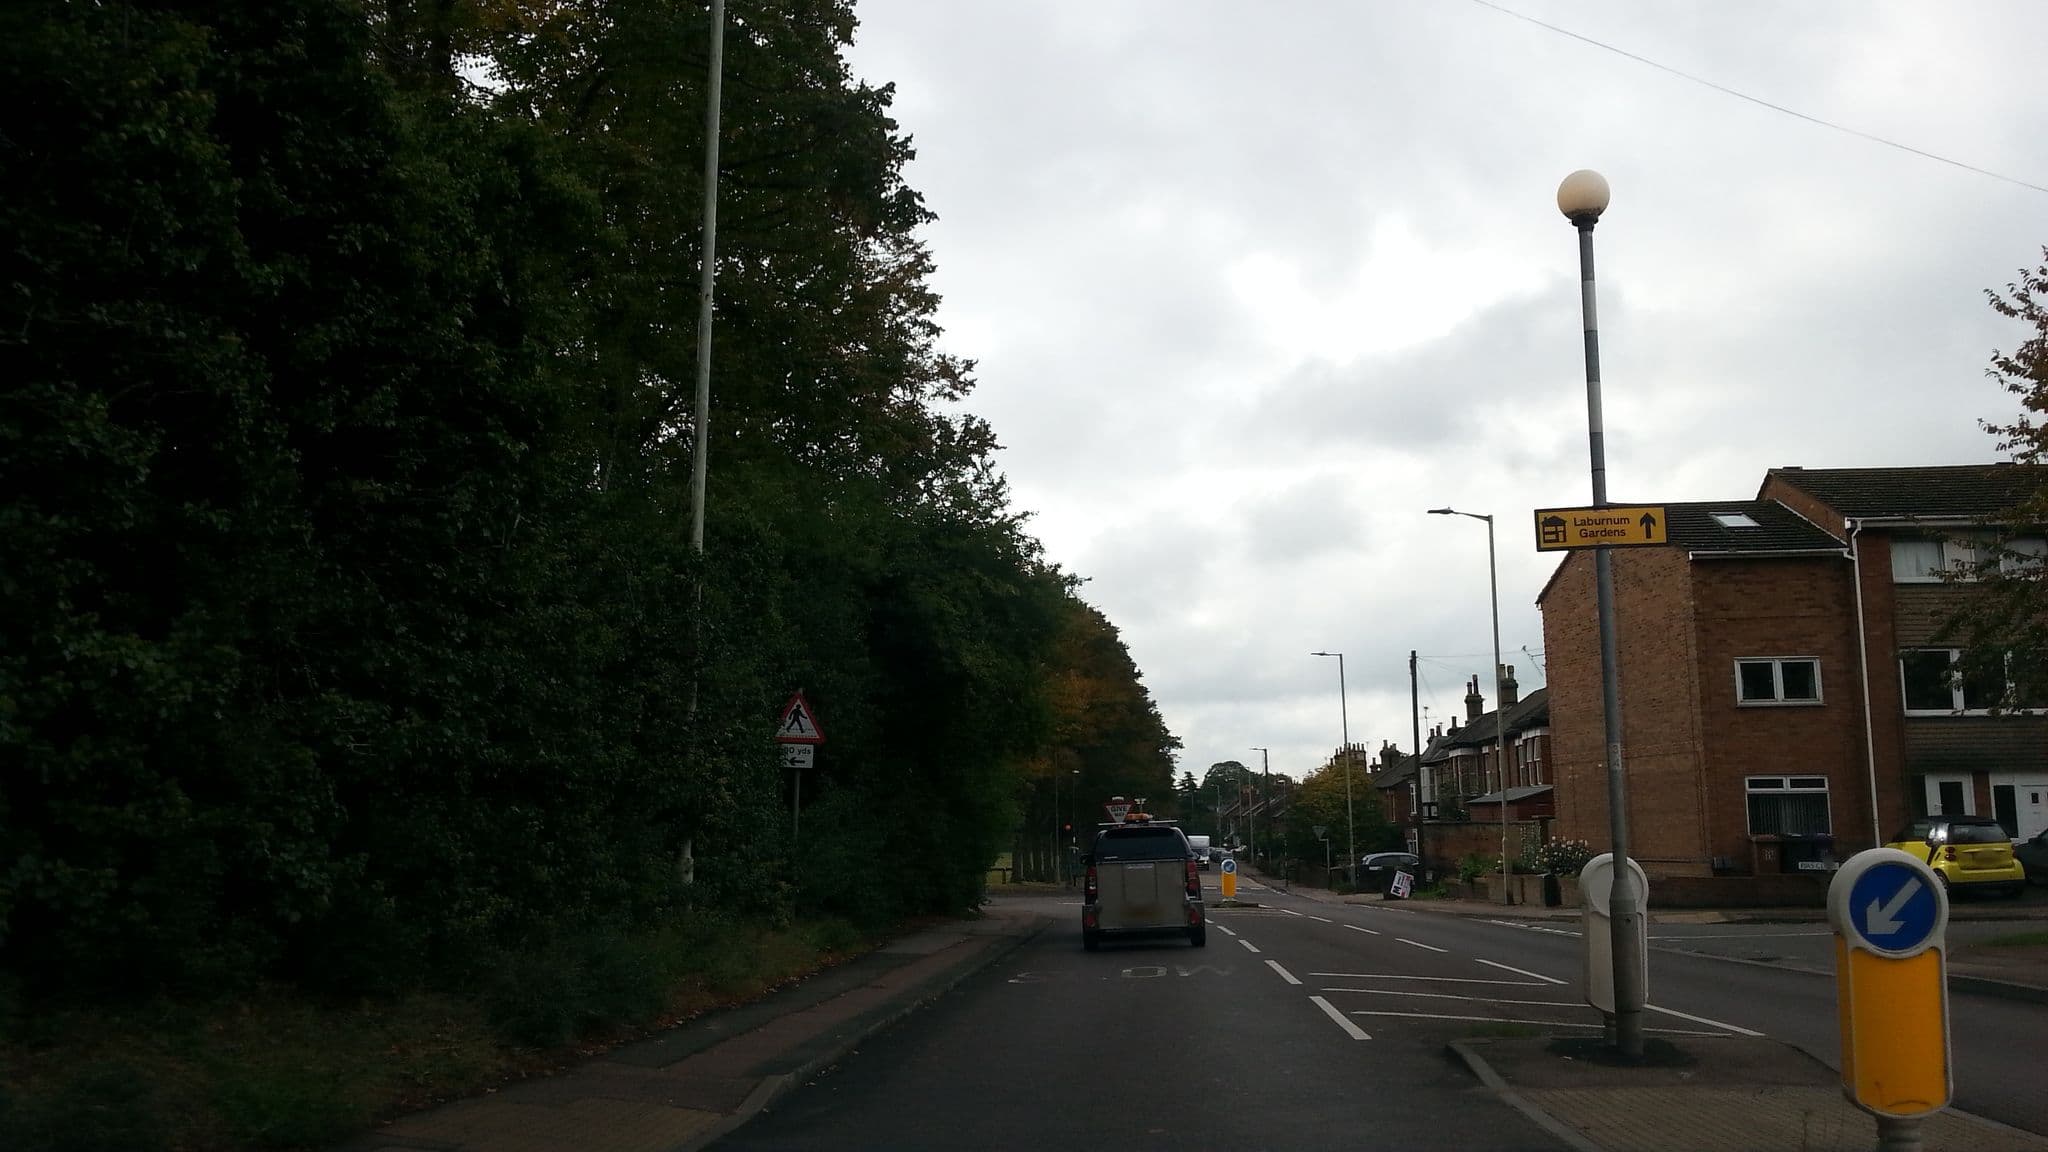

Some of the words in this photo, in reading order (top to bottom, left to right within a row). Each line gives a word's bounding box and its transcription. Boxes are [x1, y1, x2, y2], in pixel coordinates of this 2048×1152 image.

[1573, 517, 1630, 527] Laburnum
[1579, 528, 1626, 538] Gardens
[797, 747, 811, 755] yds
